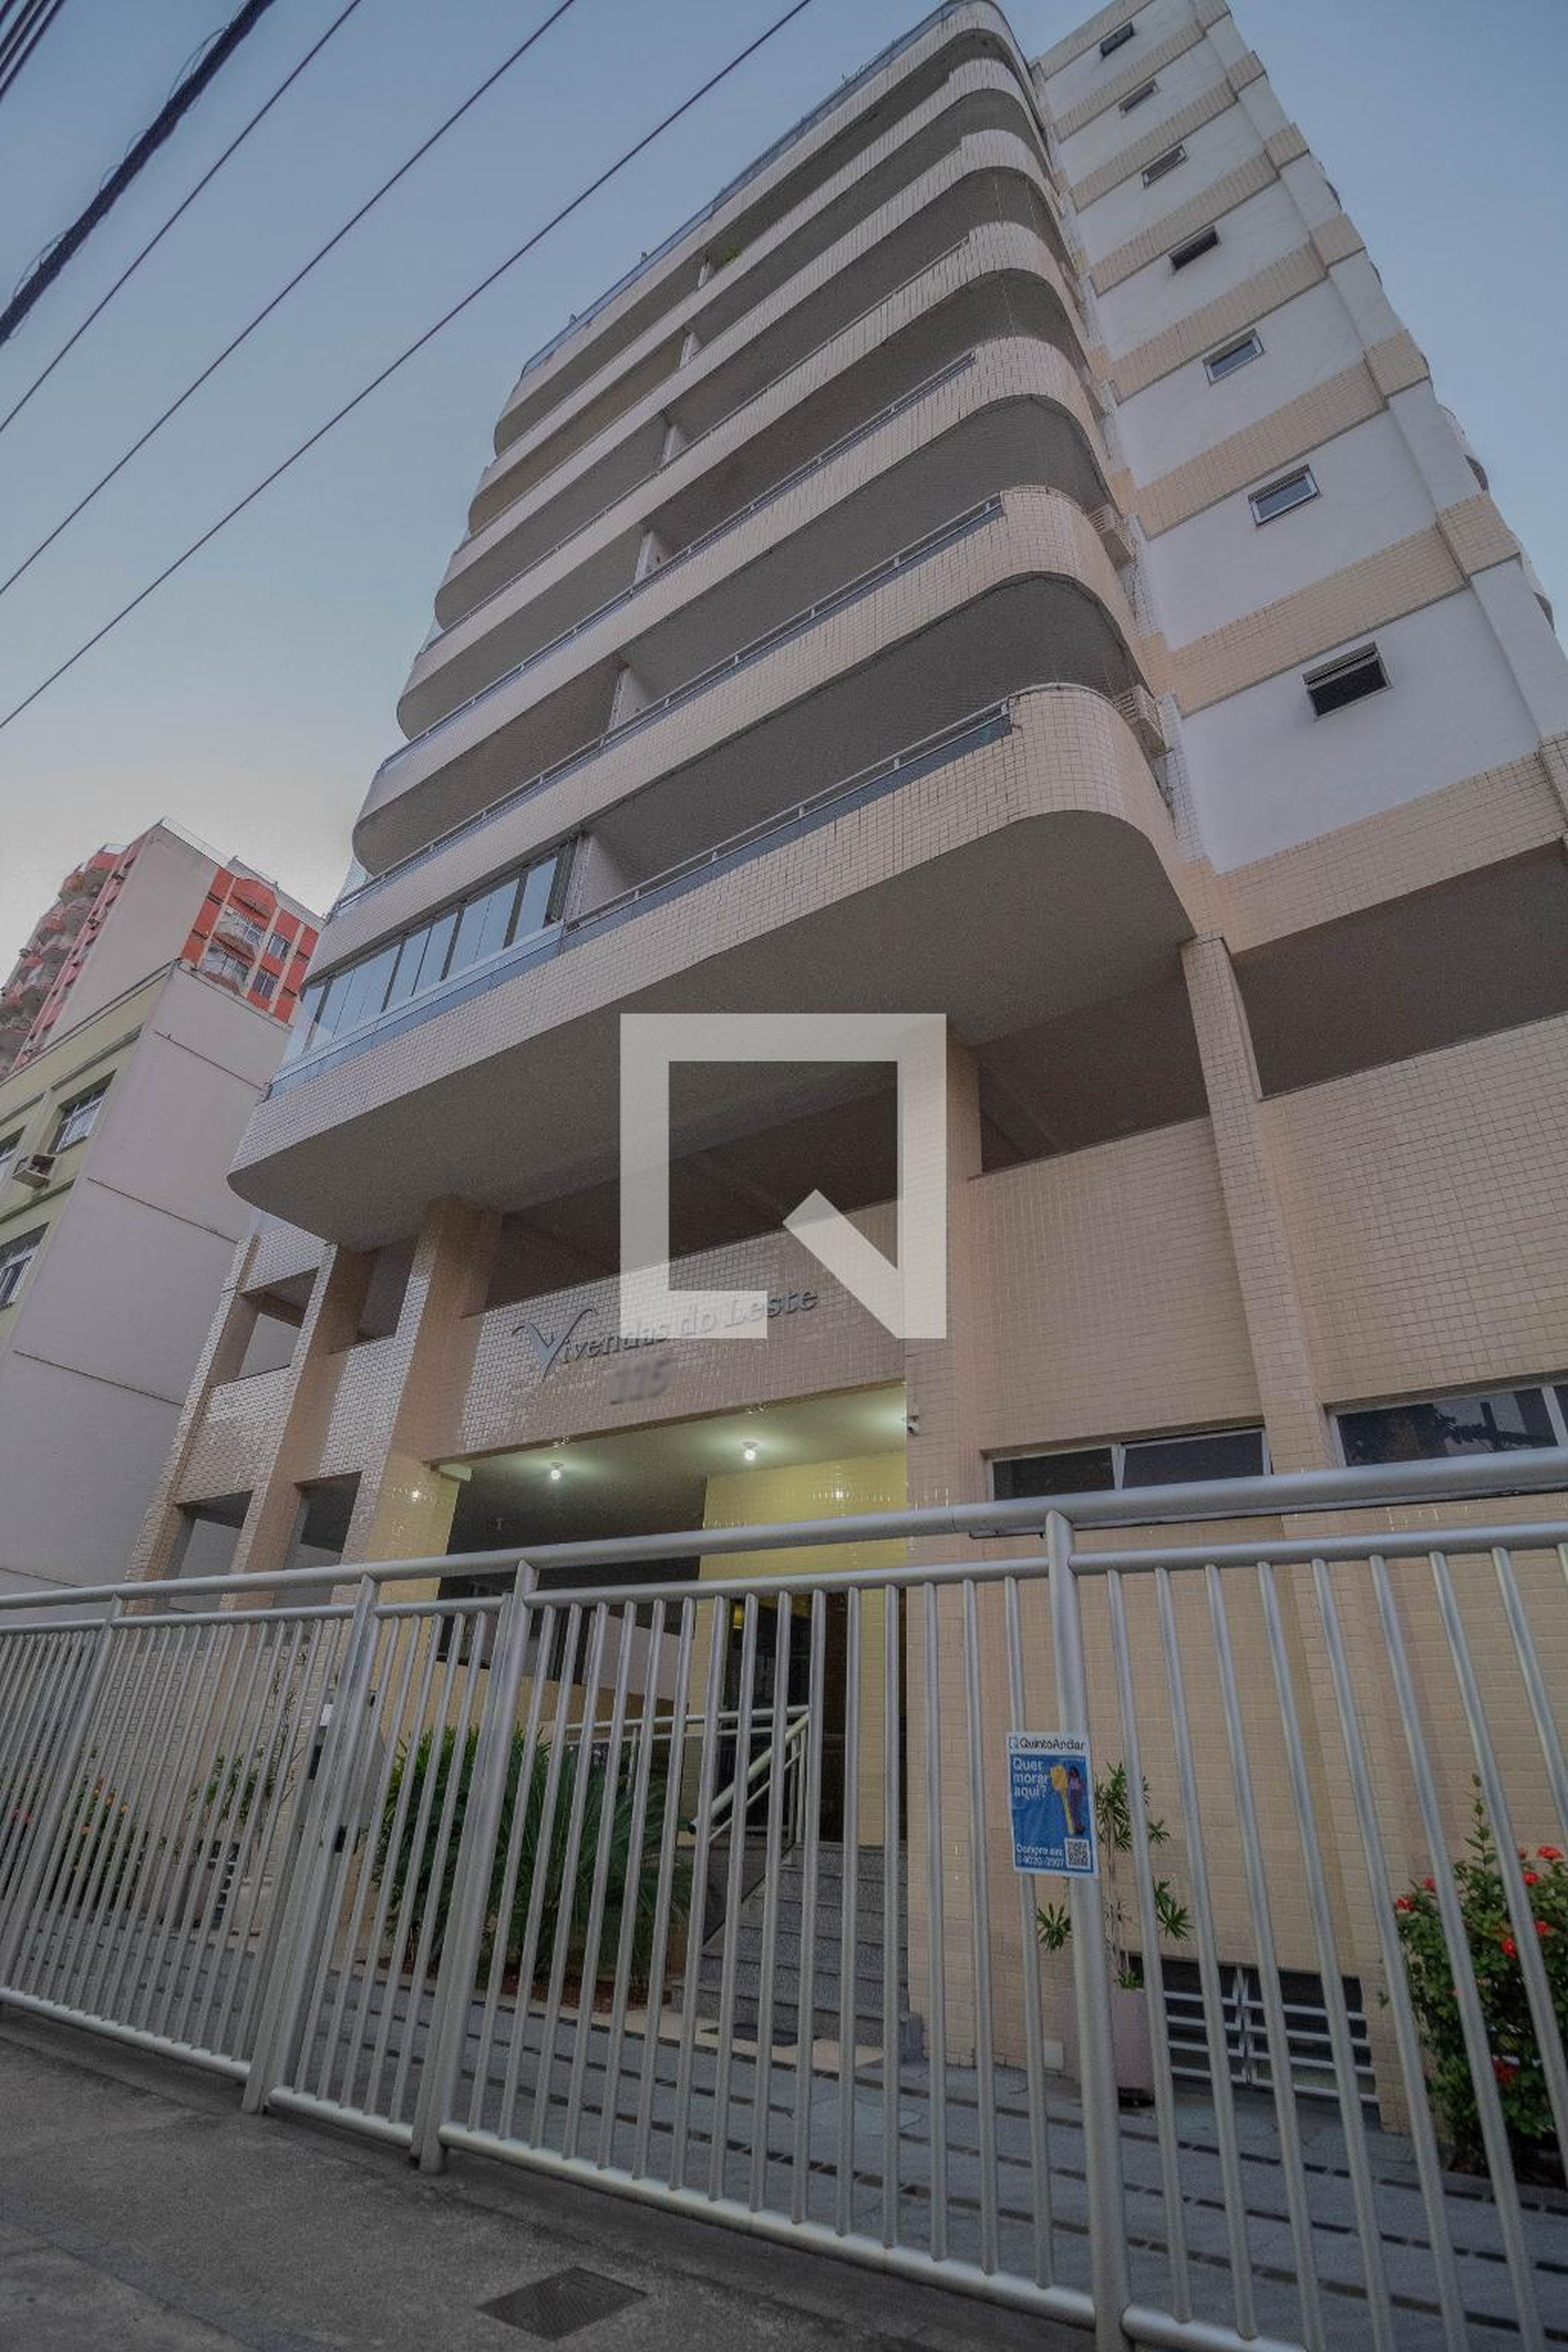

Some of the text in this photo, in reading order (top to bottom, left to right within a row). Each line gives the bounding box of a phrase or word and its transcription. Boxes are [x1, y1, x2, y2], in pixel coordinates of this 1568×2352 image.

[511, 1291, 819, 1382] Vivendas do Leste
[1020, 1737, 1085, 1750] QuintoAndar
[1013, 1773, 1049, 1784] morar
[1014, 1784, 1047, 1800] aqui?
